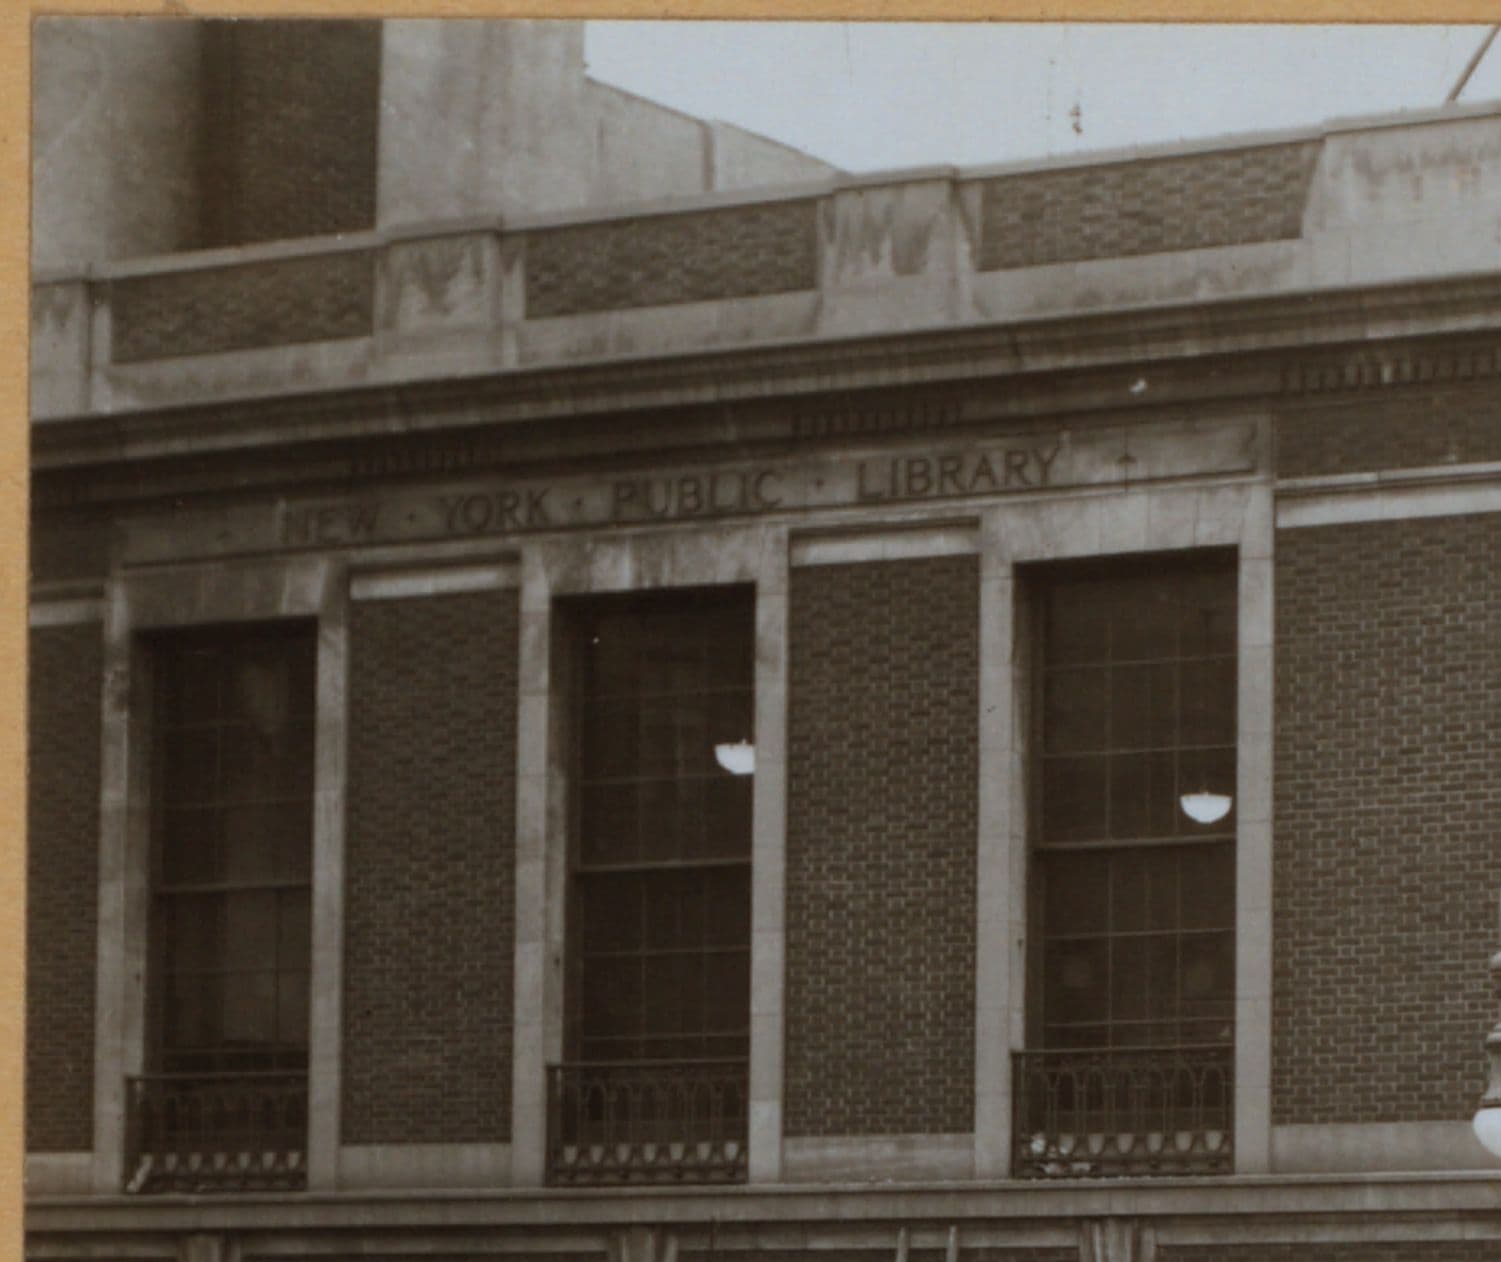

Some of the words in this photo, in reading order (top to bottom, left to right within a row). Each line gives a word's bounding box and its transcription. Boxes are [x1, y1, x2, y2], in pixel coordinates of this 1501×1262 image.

[280, 502, 378, 546] NEW
[441, 486, 551, 534] YORK
[610, 470, 784, 520] PUBLIC
[854, 446, 1062, 501] LIBRARY
